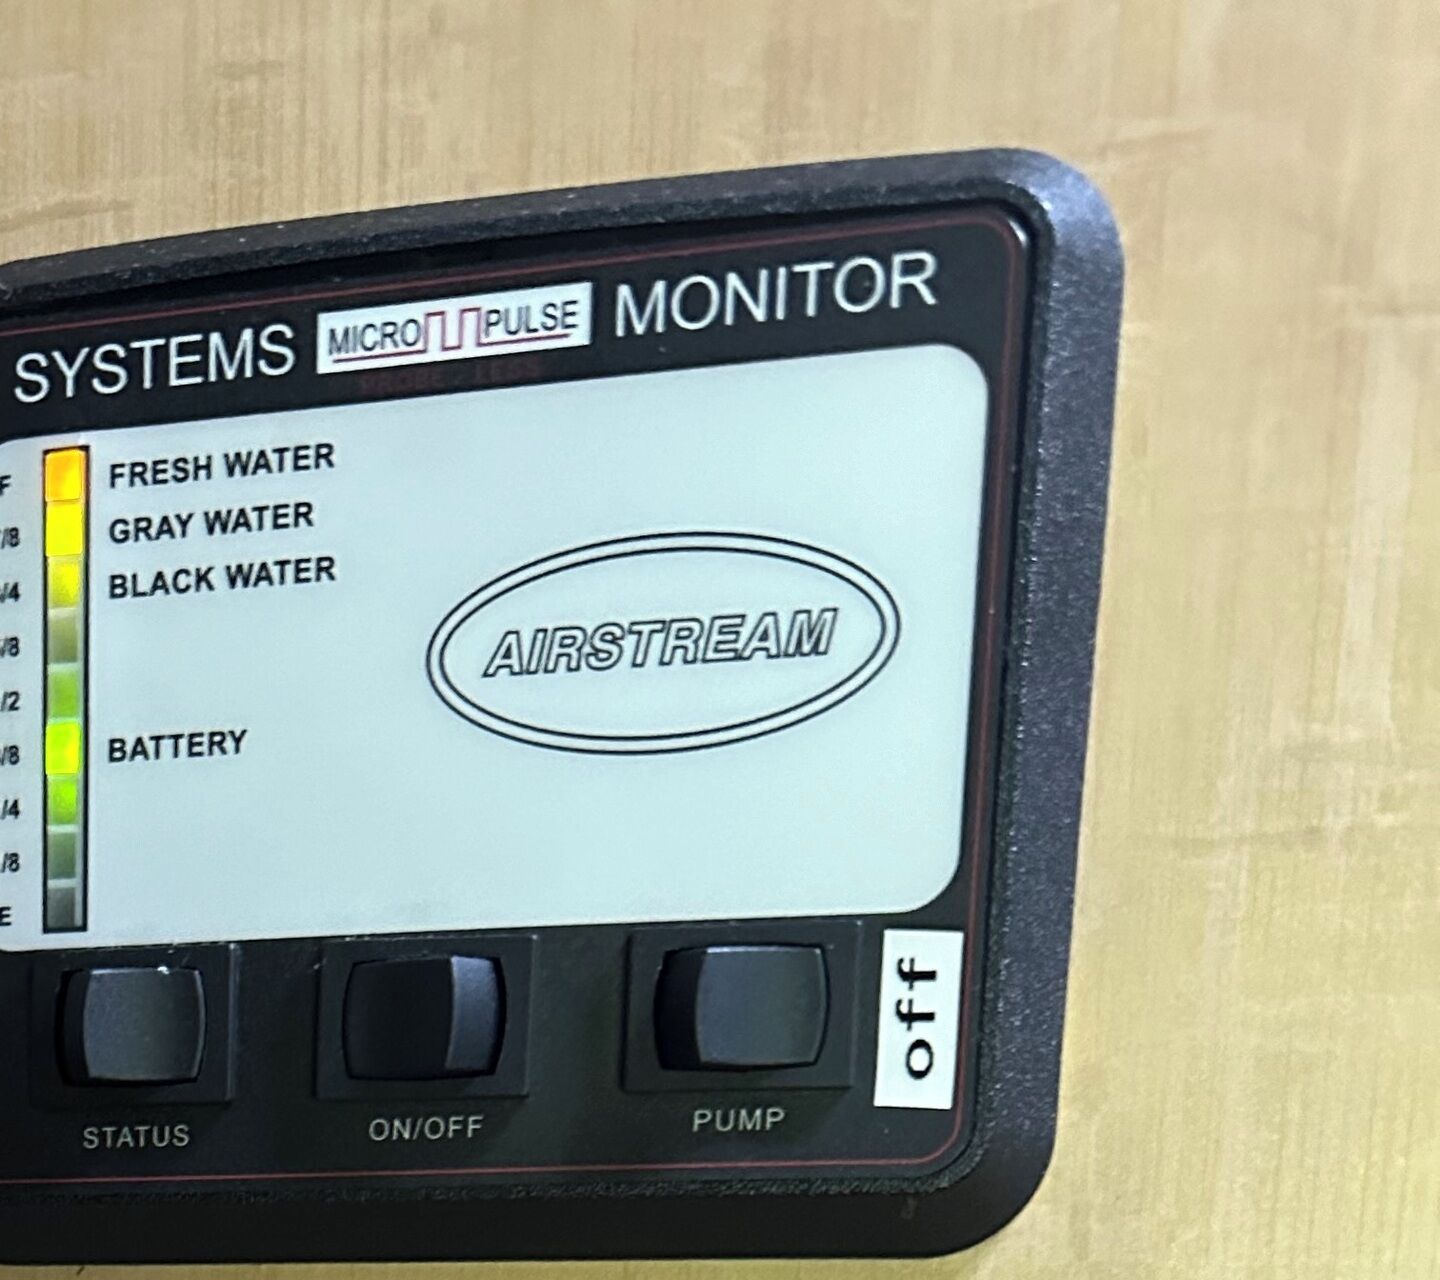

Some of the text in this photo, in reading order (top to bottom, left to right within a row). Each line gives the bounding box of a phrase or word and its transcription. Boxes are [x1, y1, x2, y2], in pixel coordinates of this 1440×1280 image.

[615, 251, 937, 337] MONITOR
[327, 299, 580, 356] MICRO PULSE
[14, 323, 295, 403] SYSTEMS
[109, 442, 335, 489] FRESH WATER
[109, 501, 314, 544] GRAY WATER
[109, 556, 336, 600] BLACK WATER
[482, 607, 839, 679] AIRSTREAM
[108, 729, 248, 763] BATTERY
[895, 957, 937, 1080] off
[83, 1124, 190, 1149] STATUS
[368, 1115, 484, 1141] ON/OFF
[692, 1107, 785, 1132] PUMP
